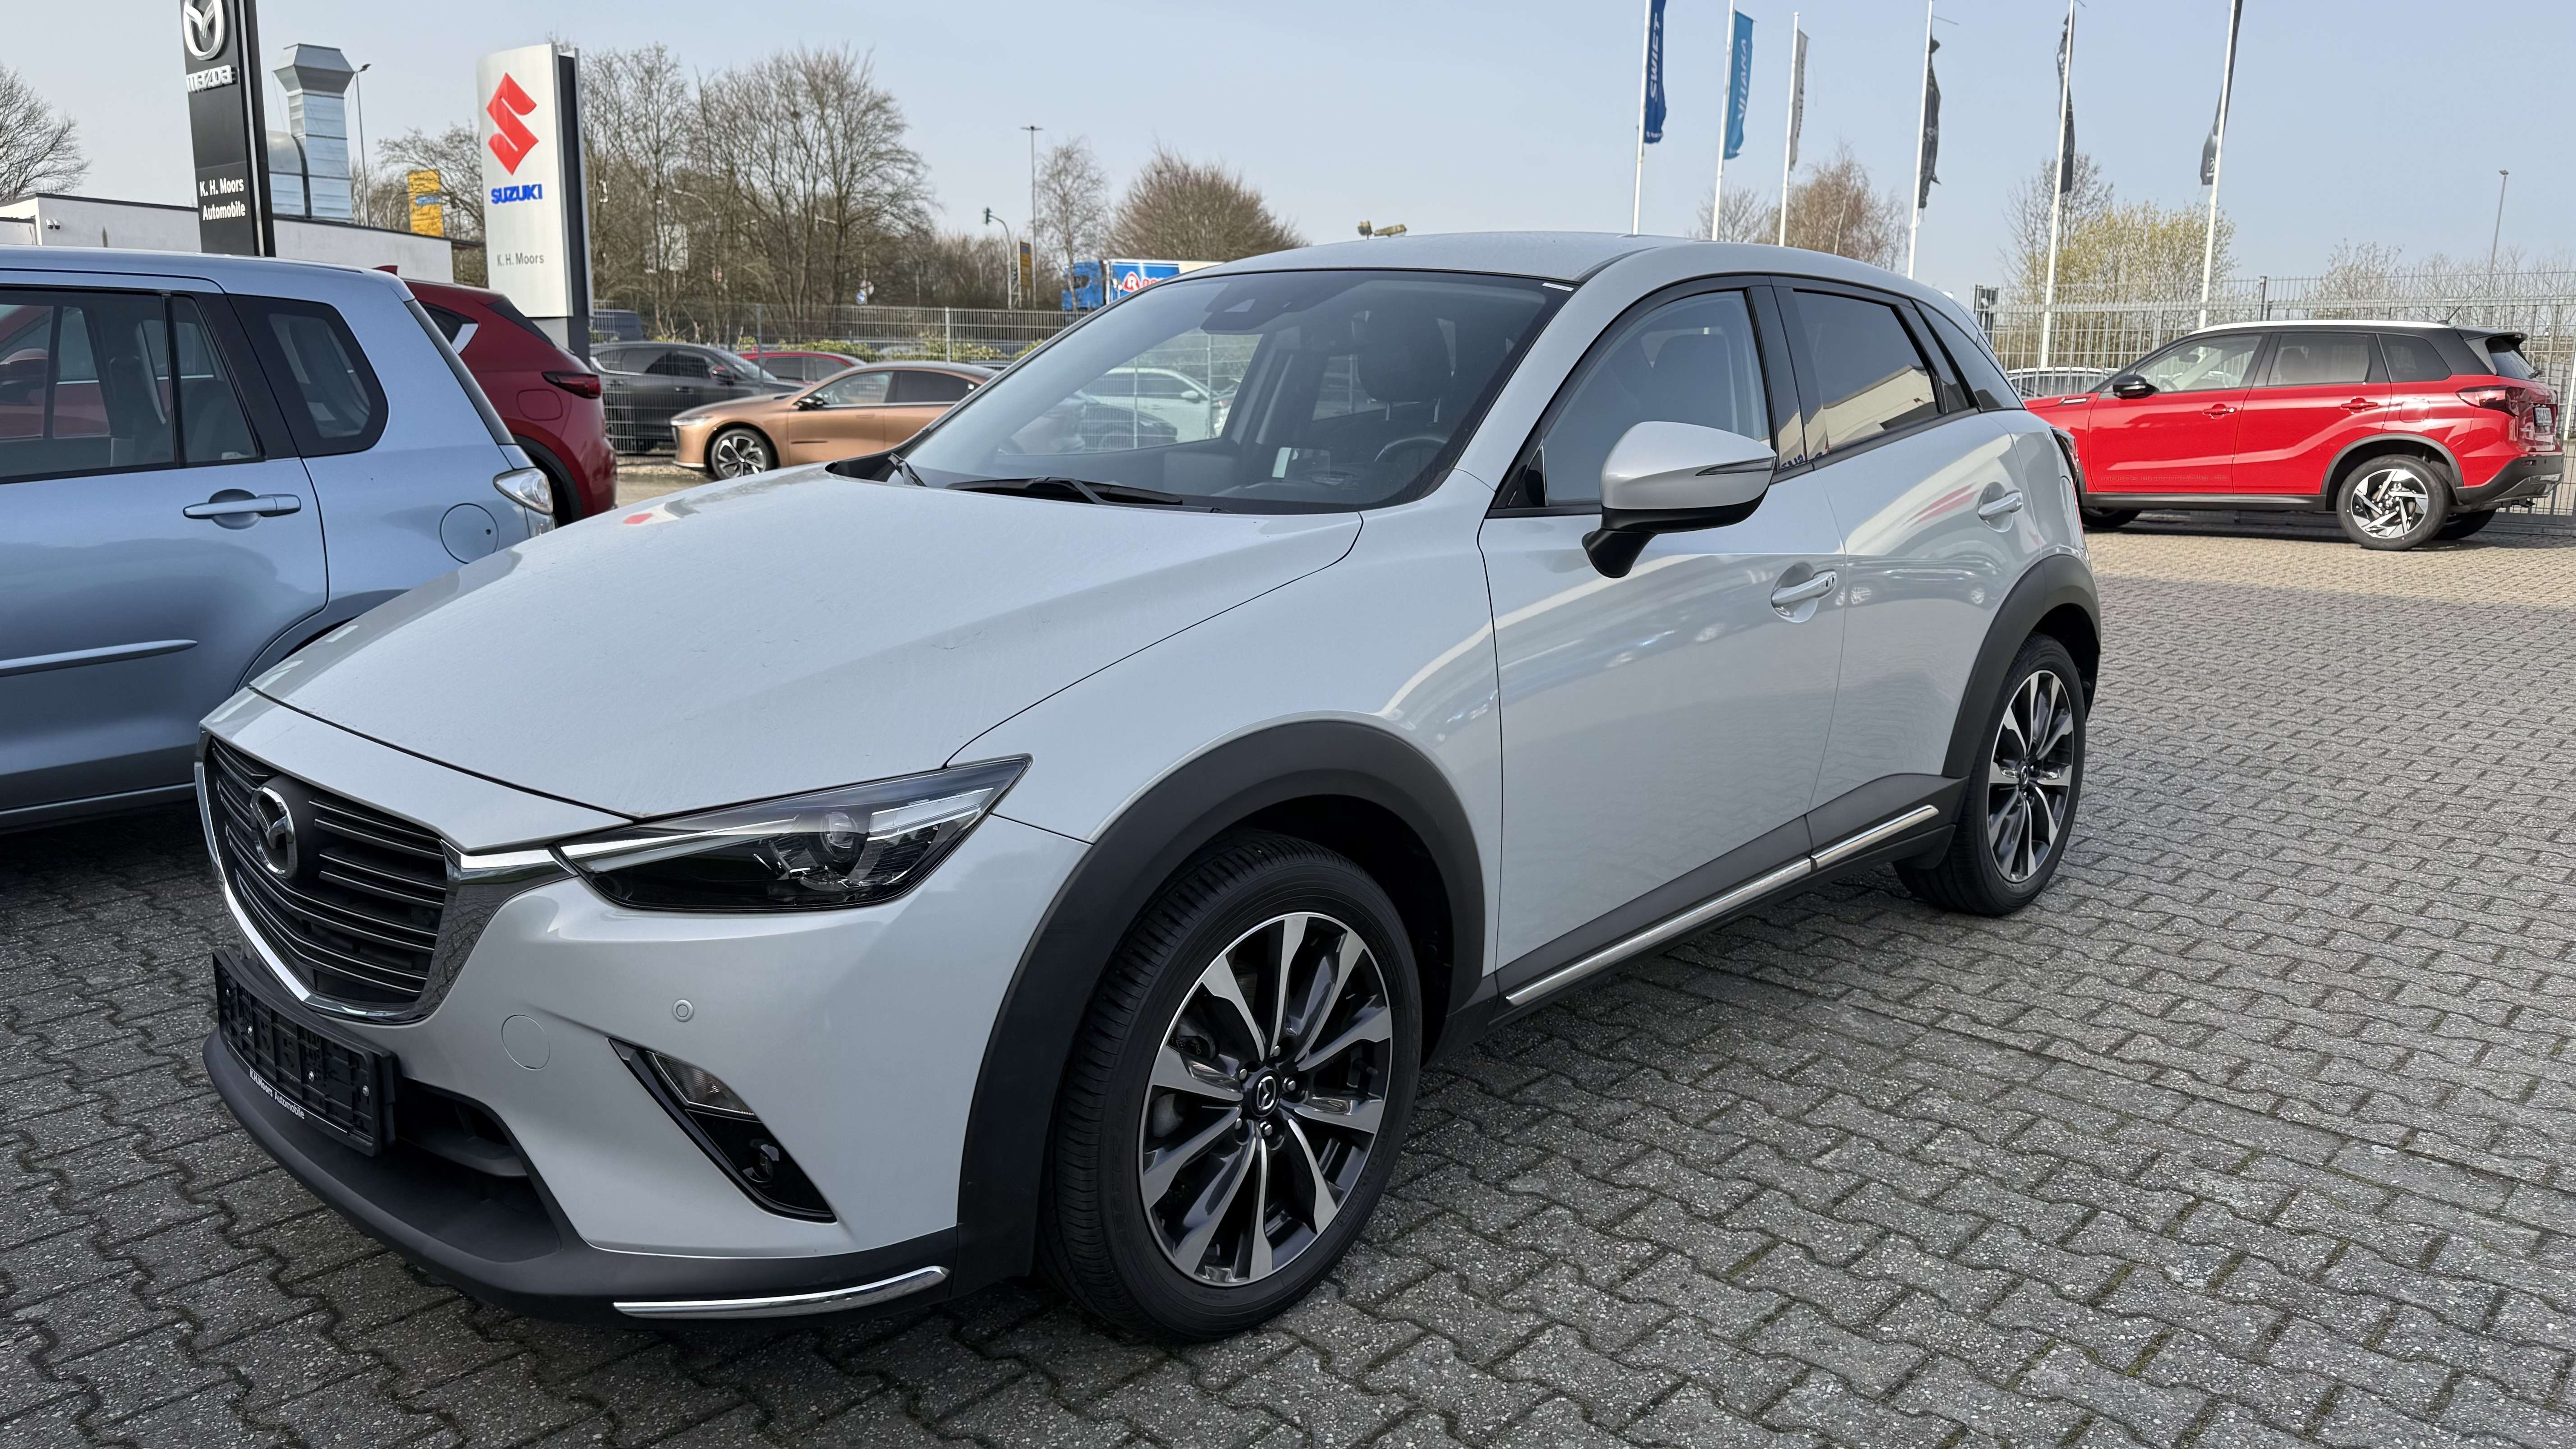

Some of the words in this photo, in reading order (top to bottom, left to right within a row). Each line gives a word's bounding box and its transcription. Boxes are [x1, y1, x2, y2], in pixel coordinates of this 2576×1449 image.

[1650, 12, 1661, 102] SWIFT
[199, 181, 208, 197] K.
[209, 179, 219, 196] H.
[220, 177, 244, 194] Moors
[491, 184, 543, 204] SUZUKI
[202, 200, 246, 221] Automobile
[497, 253, 505, 267] K.
[506, 253, 515, 266] H.
[515, 252, 545, 265] Moors
[275, 1091, 304, 1119] Automobile
